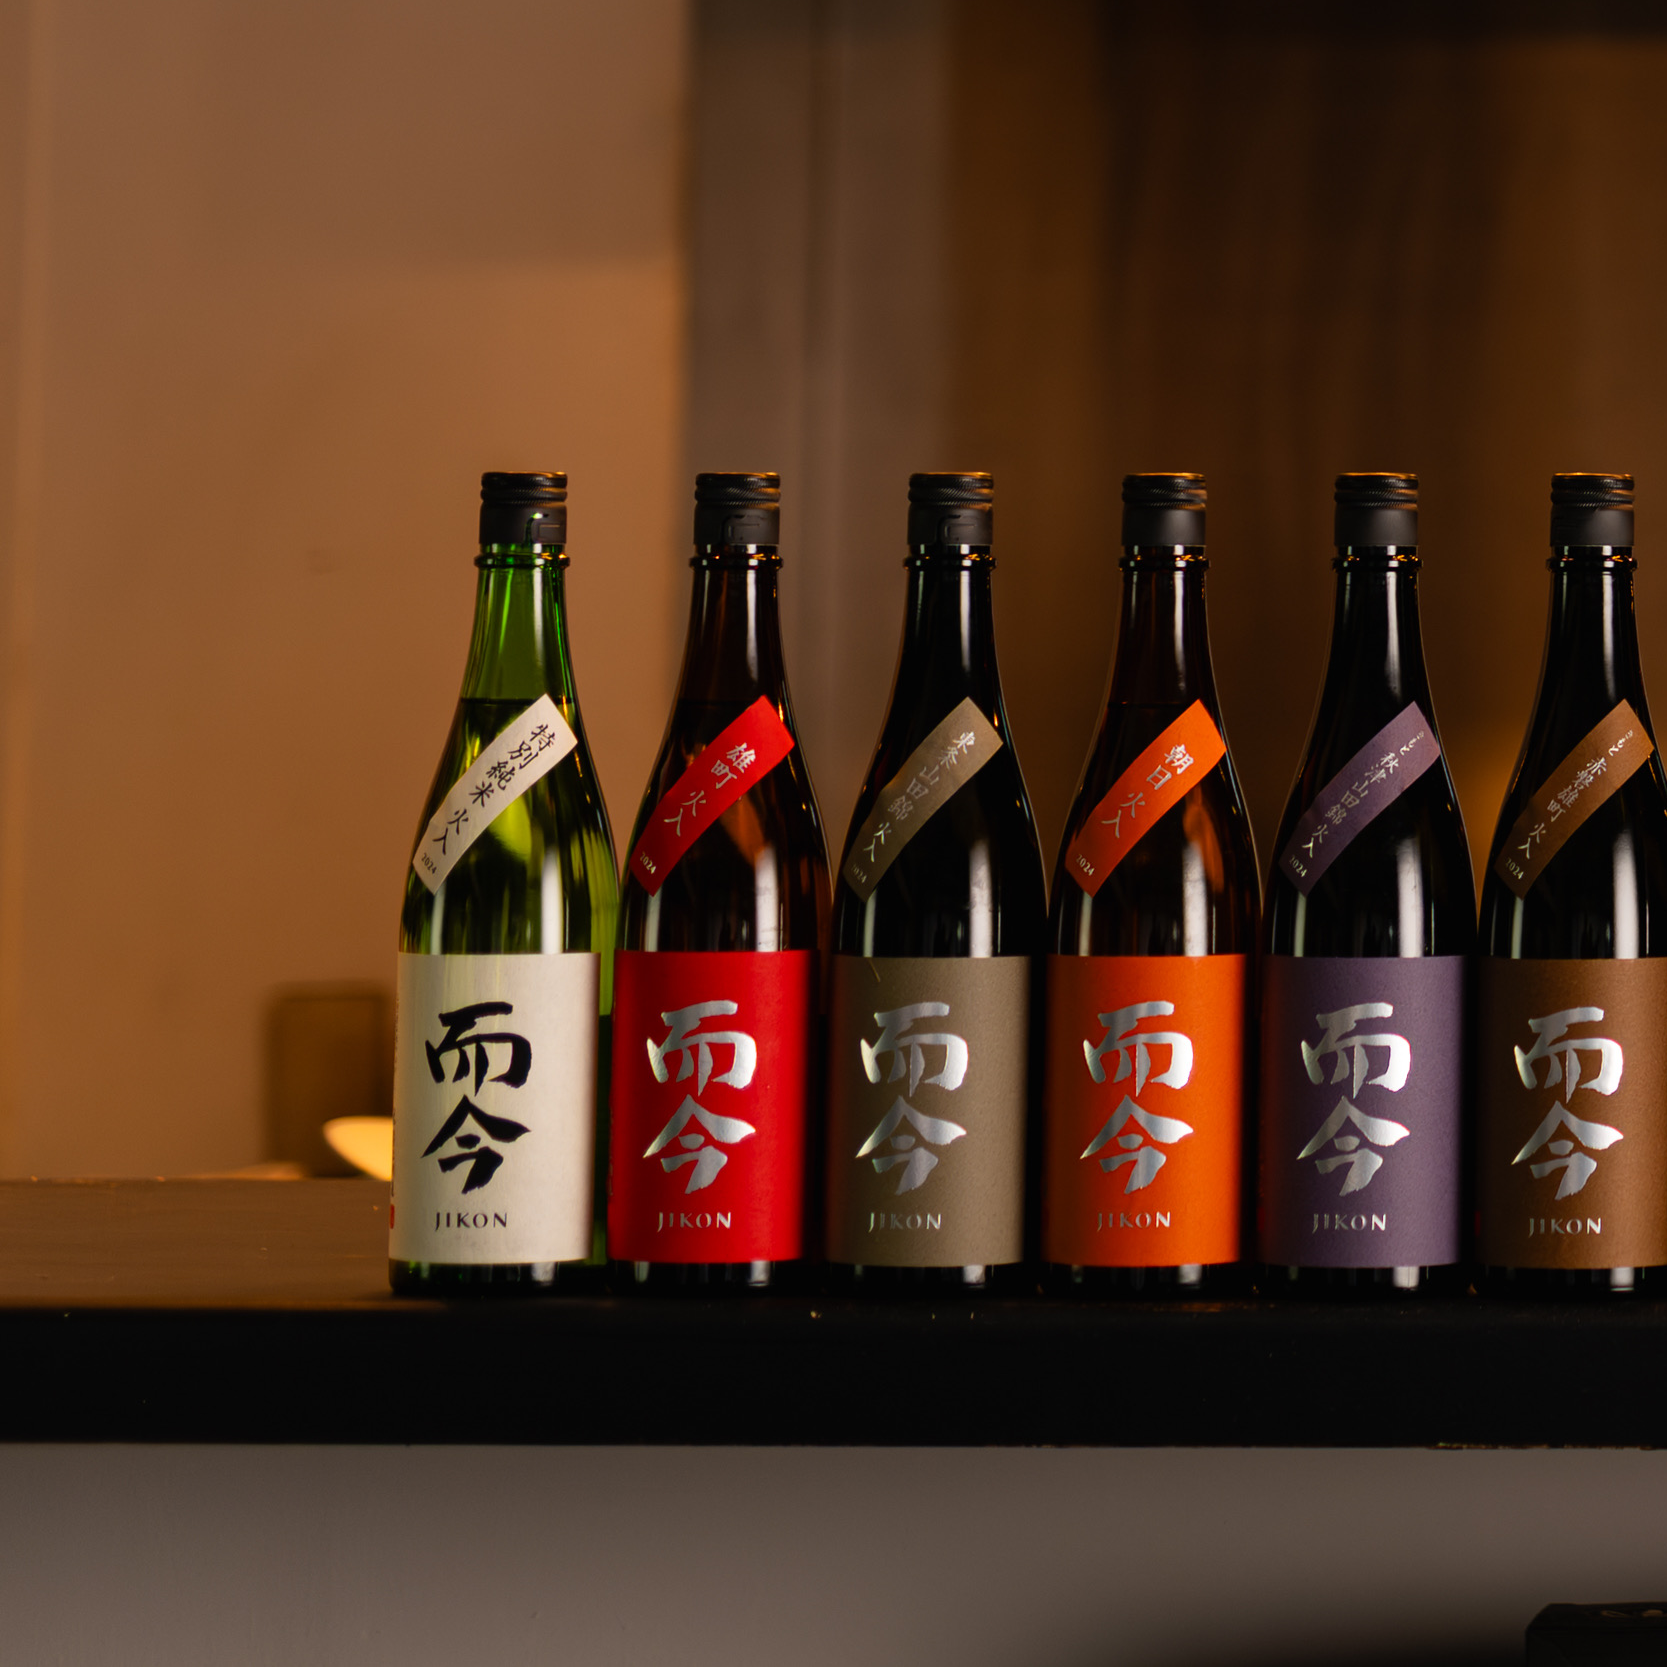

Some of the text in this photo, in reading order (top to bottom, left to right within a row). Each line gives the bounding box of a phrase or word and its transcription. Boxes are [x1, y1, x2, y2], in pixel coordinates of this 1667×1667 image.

[433, 724, 555, 855] 特別純米 火入
[664, 742, 756, 836] 雄町 火入
[1101, 744, 1194, 838] 朝日 火入
[864, 822, 892, 862] 火入
[1302, 824, 1328, 858] 火入
[1518, 823, 1546, 859] 火入
[421, 853, 437, 874] 2024
[640, 852, 656, 874] 2024
[1076, 854, 1095, 876] 2024
[1289, 855, 1307, 877] 2024
[1506, 858, 1524, 880] 2024
[421, 1000, 532, 1194] 而今
[643, 1000, 756, 1194] 而今
[855, 1001, 968, 1195] 而今
[1080, 1000, 1194, 1194] 而今
[1297, 1001, 1411, 1196] 而今
[1511, 1006, 1623, 1200] 而今
[434, 1212, 508, 1232] JIKON
[656, 1212, 732, 1232] JIKON
[868, 1212, 942, 1232] JIKON
[1097, 1211, 1171, 1231] JIKON
[1312, 1213, 1386, 1233] JIKON
[1528, 1217, 1602, 1237] JIKON
